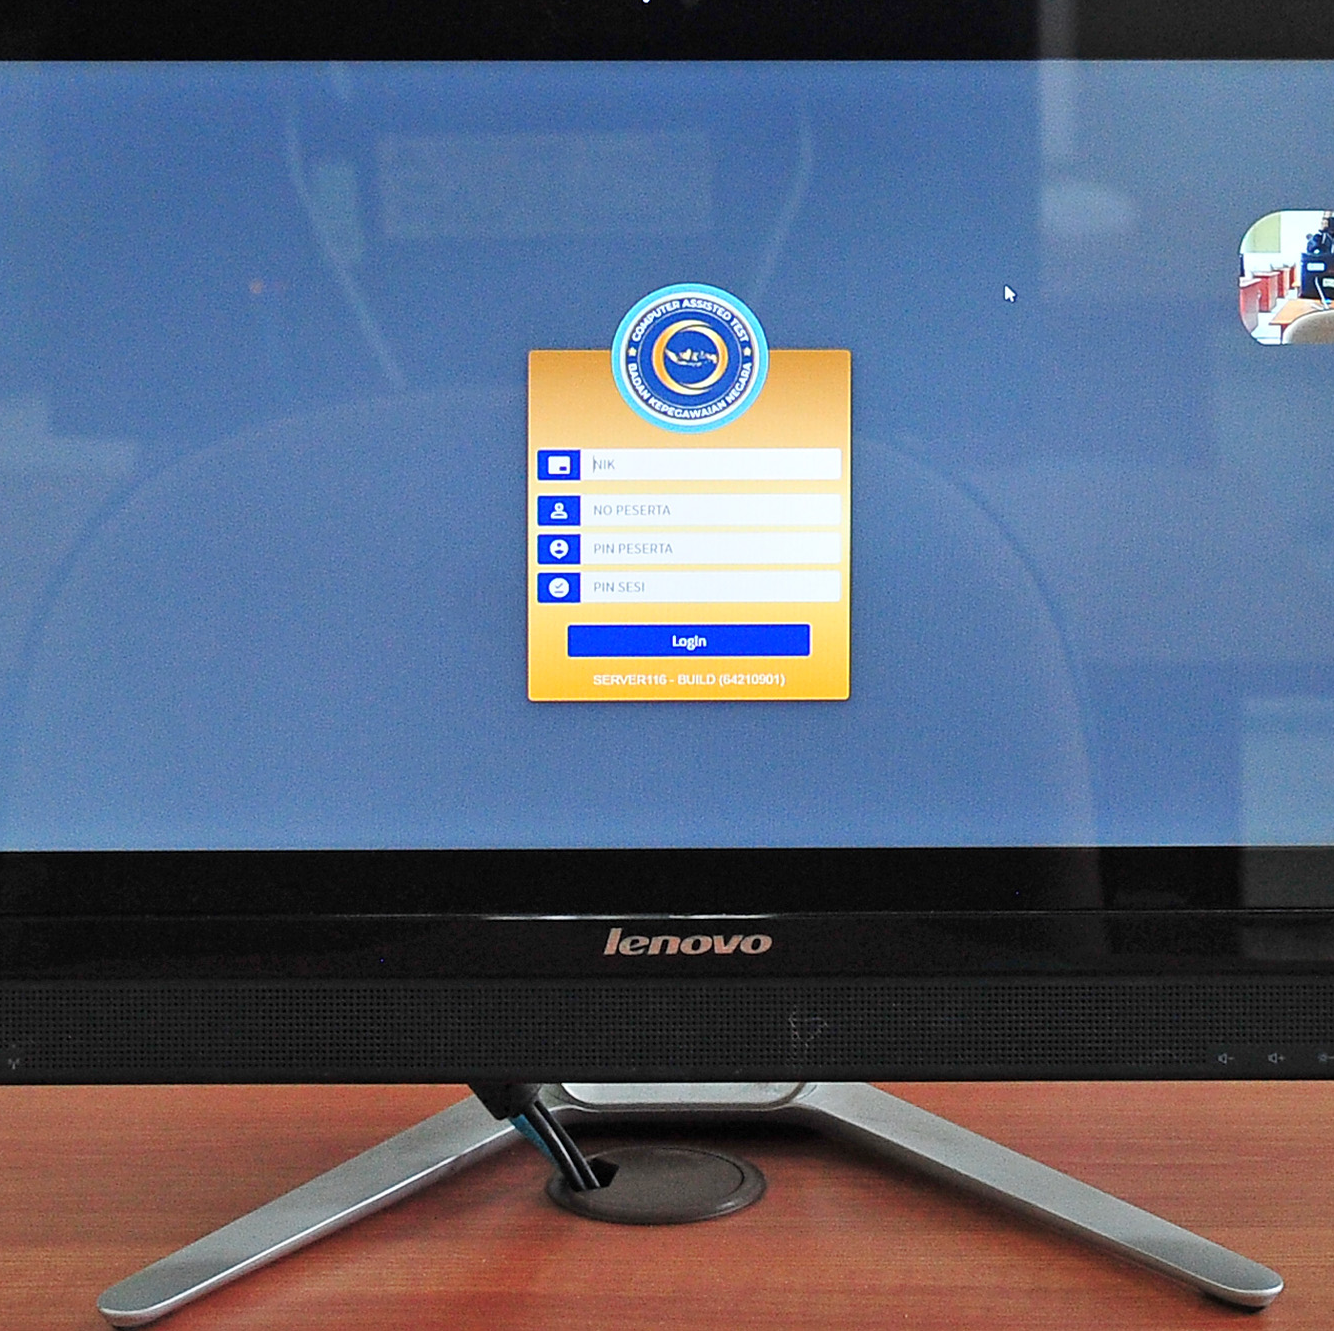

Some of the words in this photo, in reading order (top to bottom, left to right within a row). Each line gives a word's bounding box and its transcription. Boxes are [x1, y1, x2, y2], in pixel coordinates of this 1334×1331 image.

[632, 300, 680, 342] COMPUTER
[682, 298, 732, 321] ASSISTED
[729, 317, 749, 343] TEST
[628, 363, 651, 400] BADAN
[648, 399, 728, 419] KEPEGAWAIAN
[726, 362, 752, 404] NEGARA
[593, 458, 615, 470] NIK
[593, 504, 613, 516] NO
[616, 504, 671, 516] PESERTA
[593, 543, 615, 554] PIN
[618, 543, 673, 554] PESERTA
[593, 581, 615, 593] PIN
[618, 581, 645, 593] SESI
[672, 634, 707, 651] Login
[593, 673, 667, 686] SERVER116
[677, 673, 716, 686] BUILD
[719, 672, 786, 687] (64210901)
[603, 927, 773, 956] lenovo
